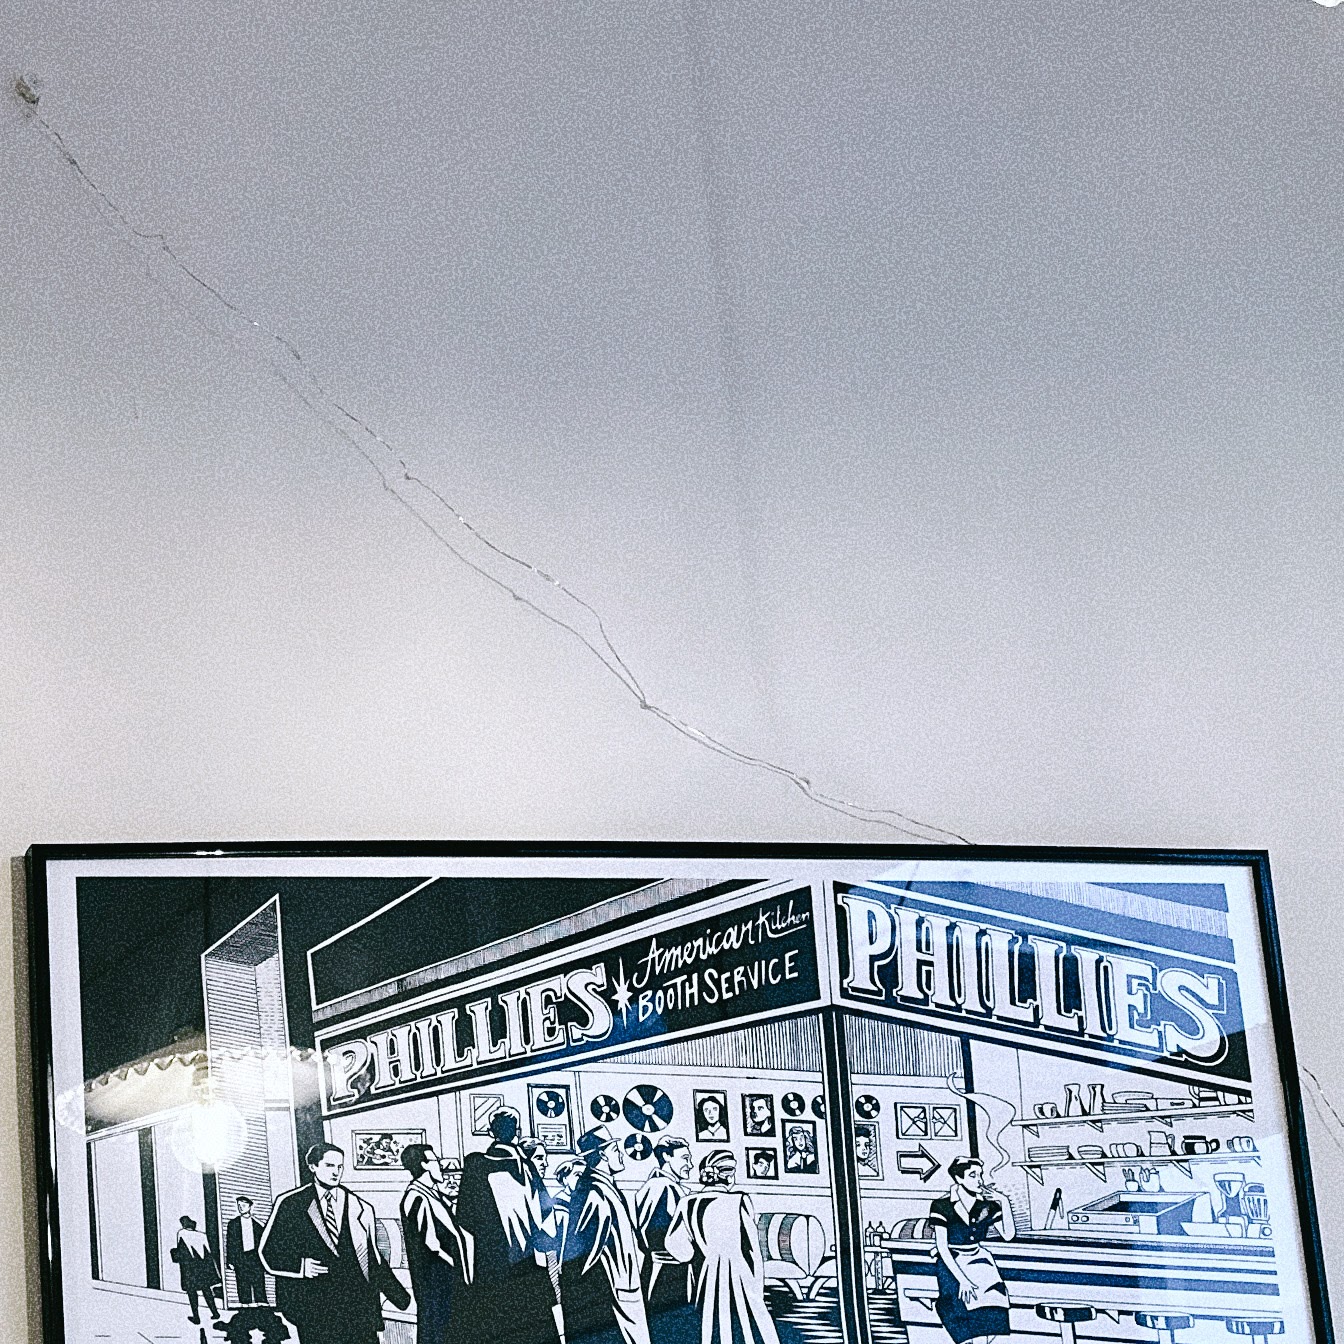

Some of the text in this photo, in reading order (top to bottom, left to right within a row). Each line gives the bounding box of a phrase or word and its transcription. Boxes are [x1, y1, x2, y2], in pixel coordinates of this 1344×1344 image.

[632, 920, 755, 989] American
[638, 949, 799, 1023] BOOTH SERVICE
[837, 893, 1229, 1066] PHILLIES
[328, 962, 615, 1104] PHILLIES
